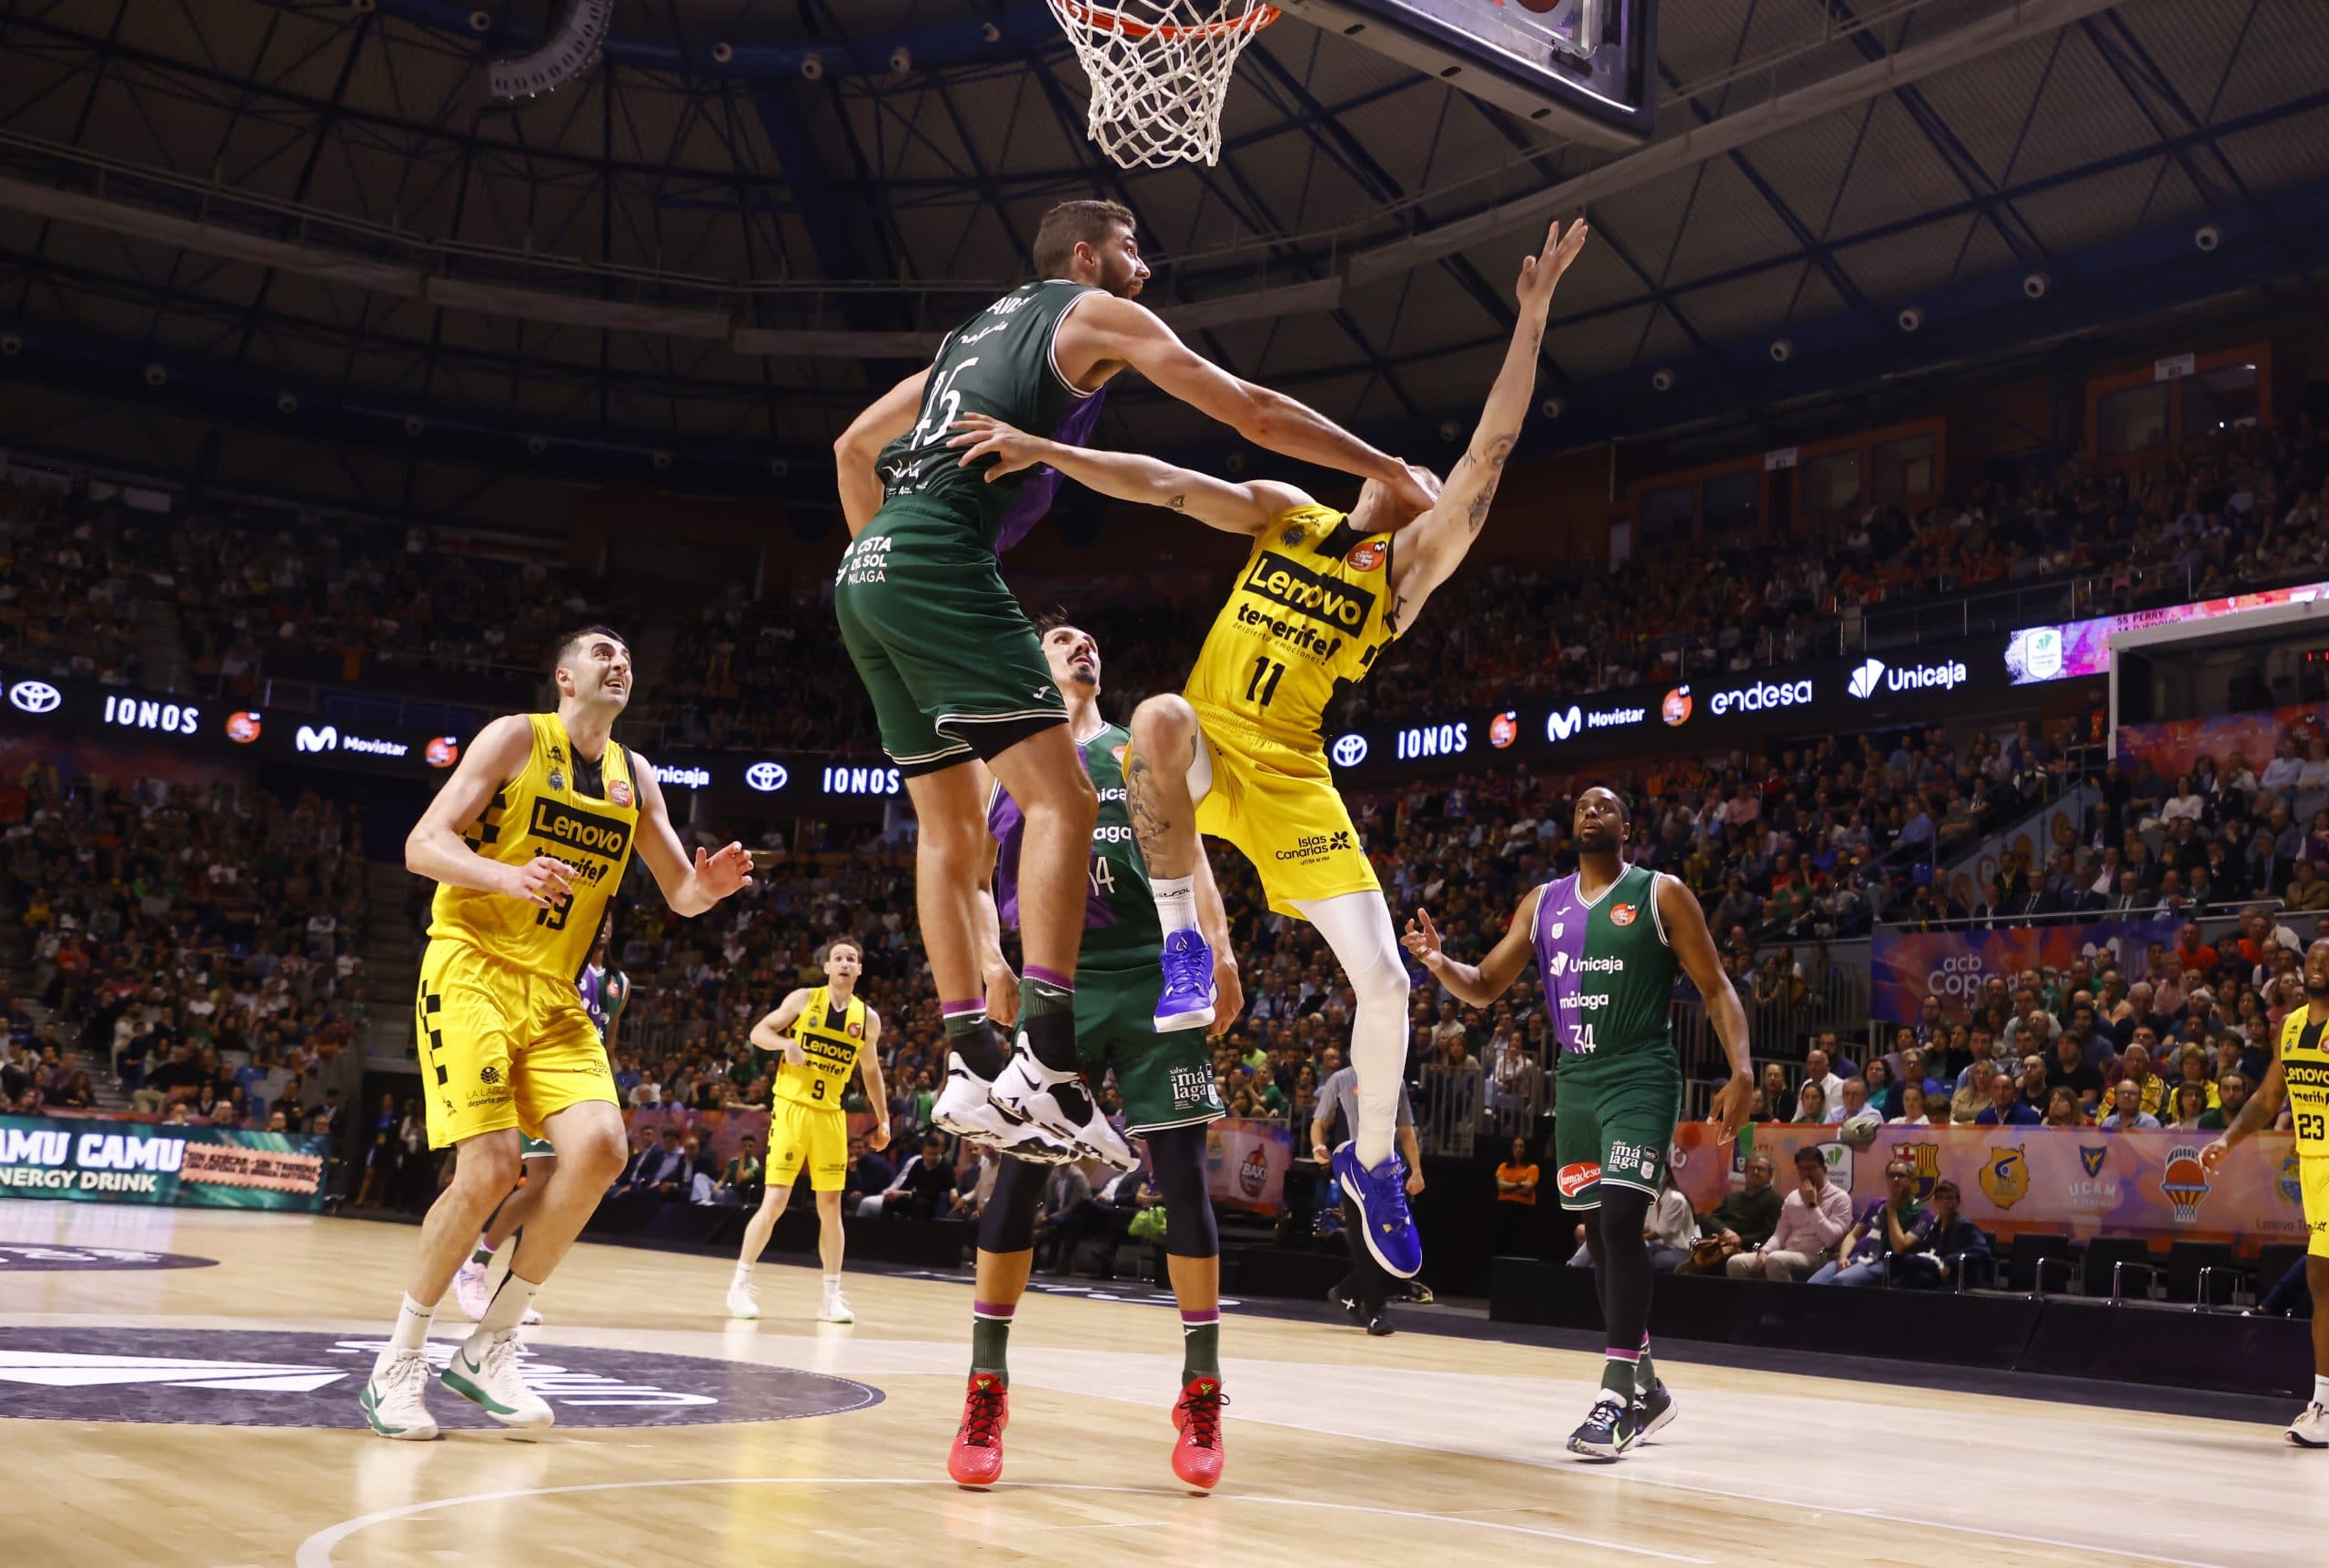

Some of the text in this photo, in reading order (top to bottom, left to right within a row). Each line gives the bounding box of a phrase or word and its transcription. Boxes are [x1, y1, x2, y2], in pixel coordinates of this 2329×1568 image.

[910, 357, 980, 451] 45
[862, 553, 888, 568] SOL
[1249, 558, 1362, 626] Lenovo
[2132, 610, 2164, 622] PERRY
[1237, 603, 1342, 666] tenerife!
[1245, 655, 1285, 708] 11
[1888, 659, 1966, 691] Unicaja
[1711, 679, 1812, 715] endesa
[105, 695, 198, 734] IONOS
[1588, 708, 1646, 729] Movistar
[343, 735, 408, 757] Movistar
[1397, 723, 1468, 760] IONOS
[823, 767, 901, 795] IONOS
[535, 803, 623, 853] Lenovo
[1275, 843, 1329, 860] Canarias
[1298, 835, 1327, 848] Islas
[1569, 956, 1623, 974] Unicaja
[1943, 953, 1982, 972] acb
[802, 1034, 852, 1062] Lenovo
[1568, 1023, 1597, 1054] 34
[1176, 1065, 1206, 1087] má
[811, 1080, 825, 1101] 9
[1171, 1082, 1207, 1102] laga
[2297, 1113, 2325, 1141] 23
[76, 1133, 187, 1172] CAMU
[1608, 1151, 1638, 1171] laga
[1615, 1144, 1641, 1160] má
[80, 1170, 158, 1192] DRINK
[2068, 1181, 2117, 1200] UCAM
